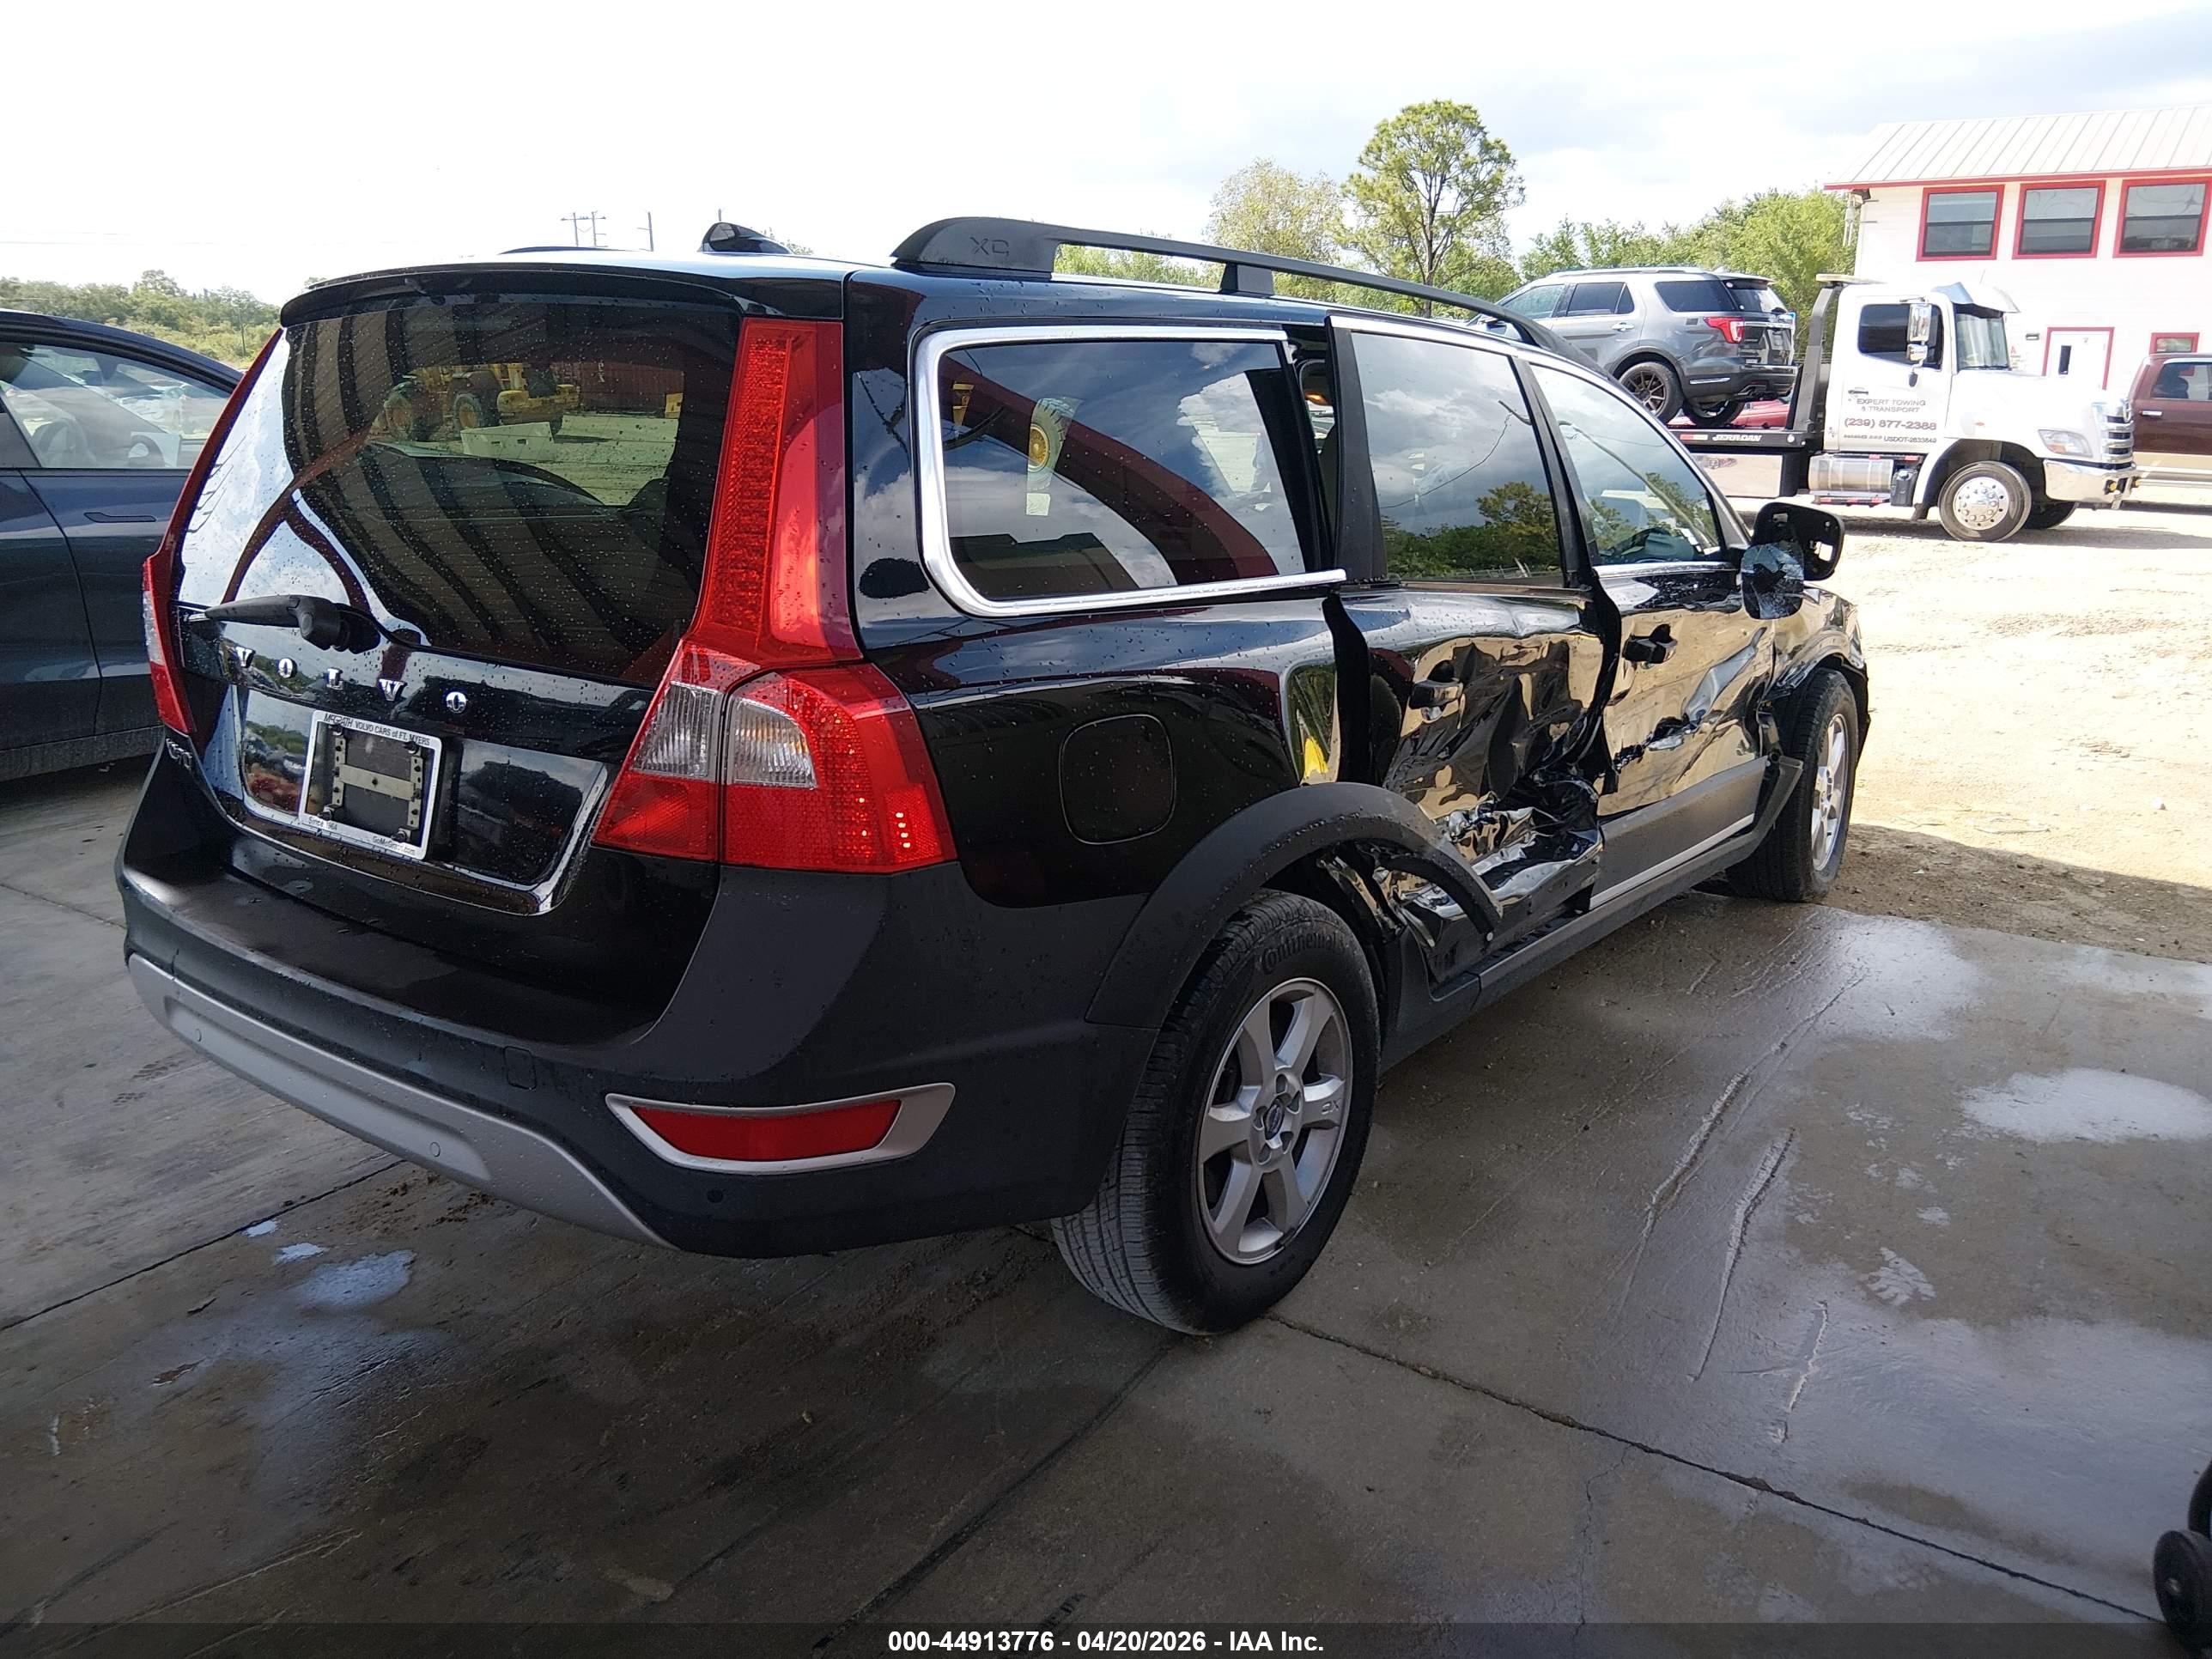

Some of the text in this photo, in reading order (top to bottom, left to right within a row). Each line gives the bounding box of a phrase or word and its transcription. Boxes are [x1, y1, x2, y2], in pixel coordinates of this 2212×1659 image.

[1844, 417, 1937, 430] (239) 877-2388
[235, 646, 468, 714] VOLVO
[355, 721, 374, 732] VOLVO
[374, 726, 391, 737] CARS
[409, 734, 430, 746] MYERS
